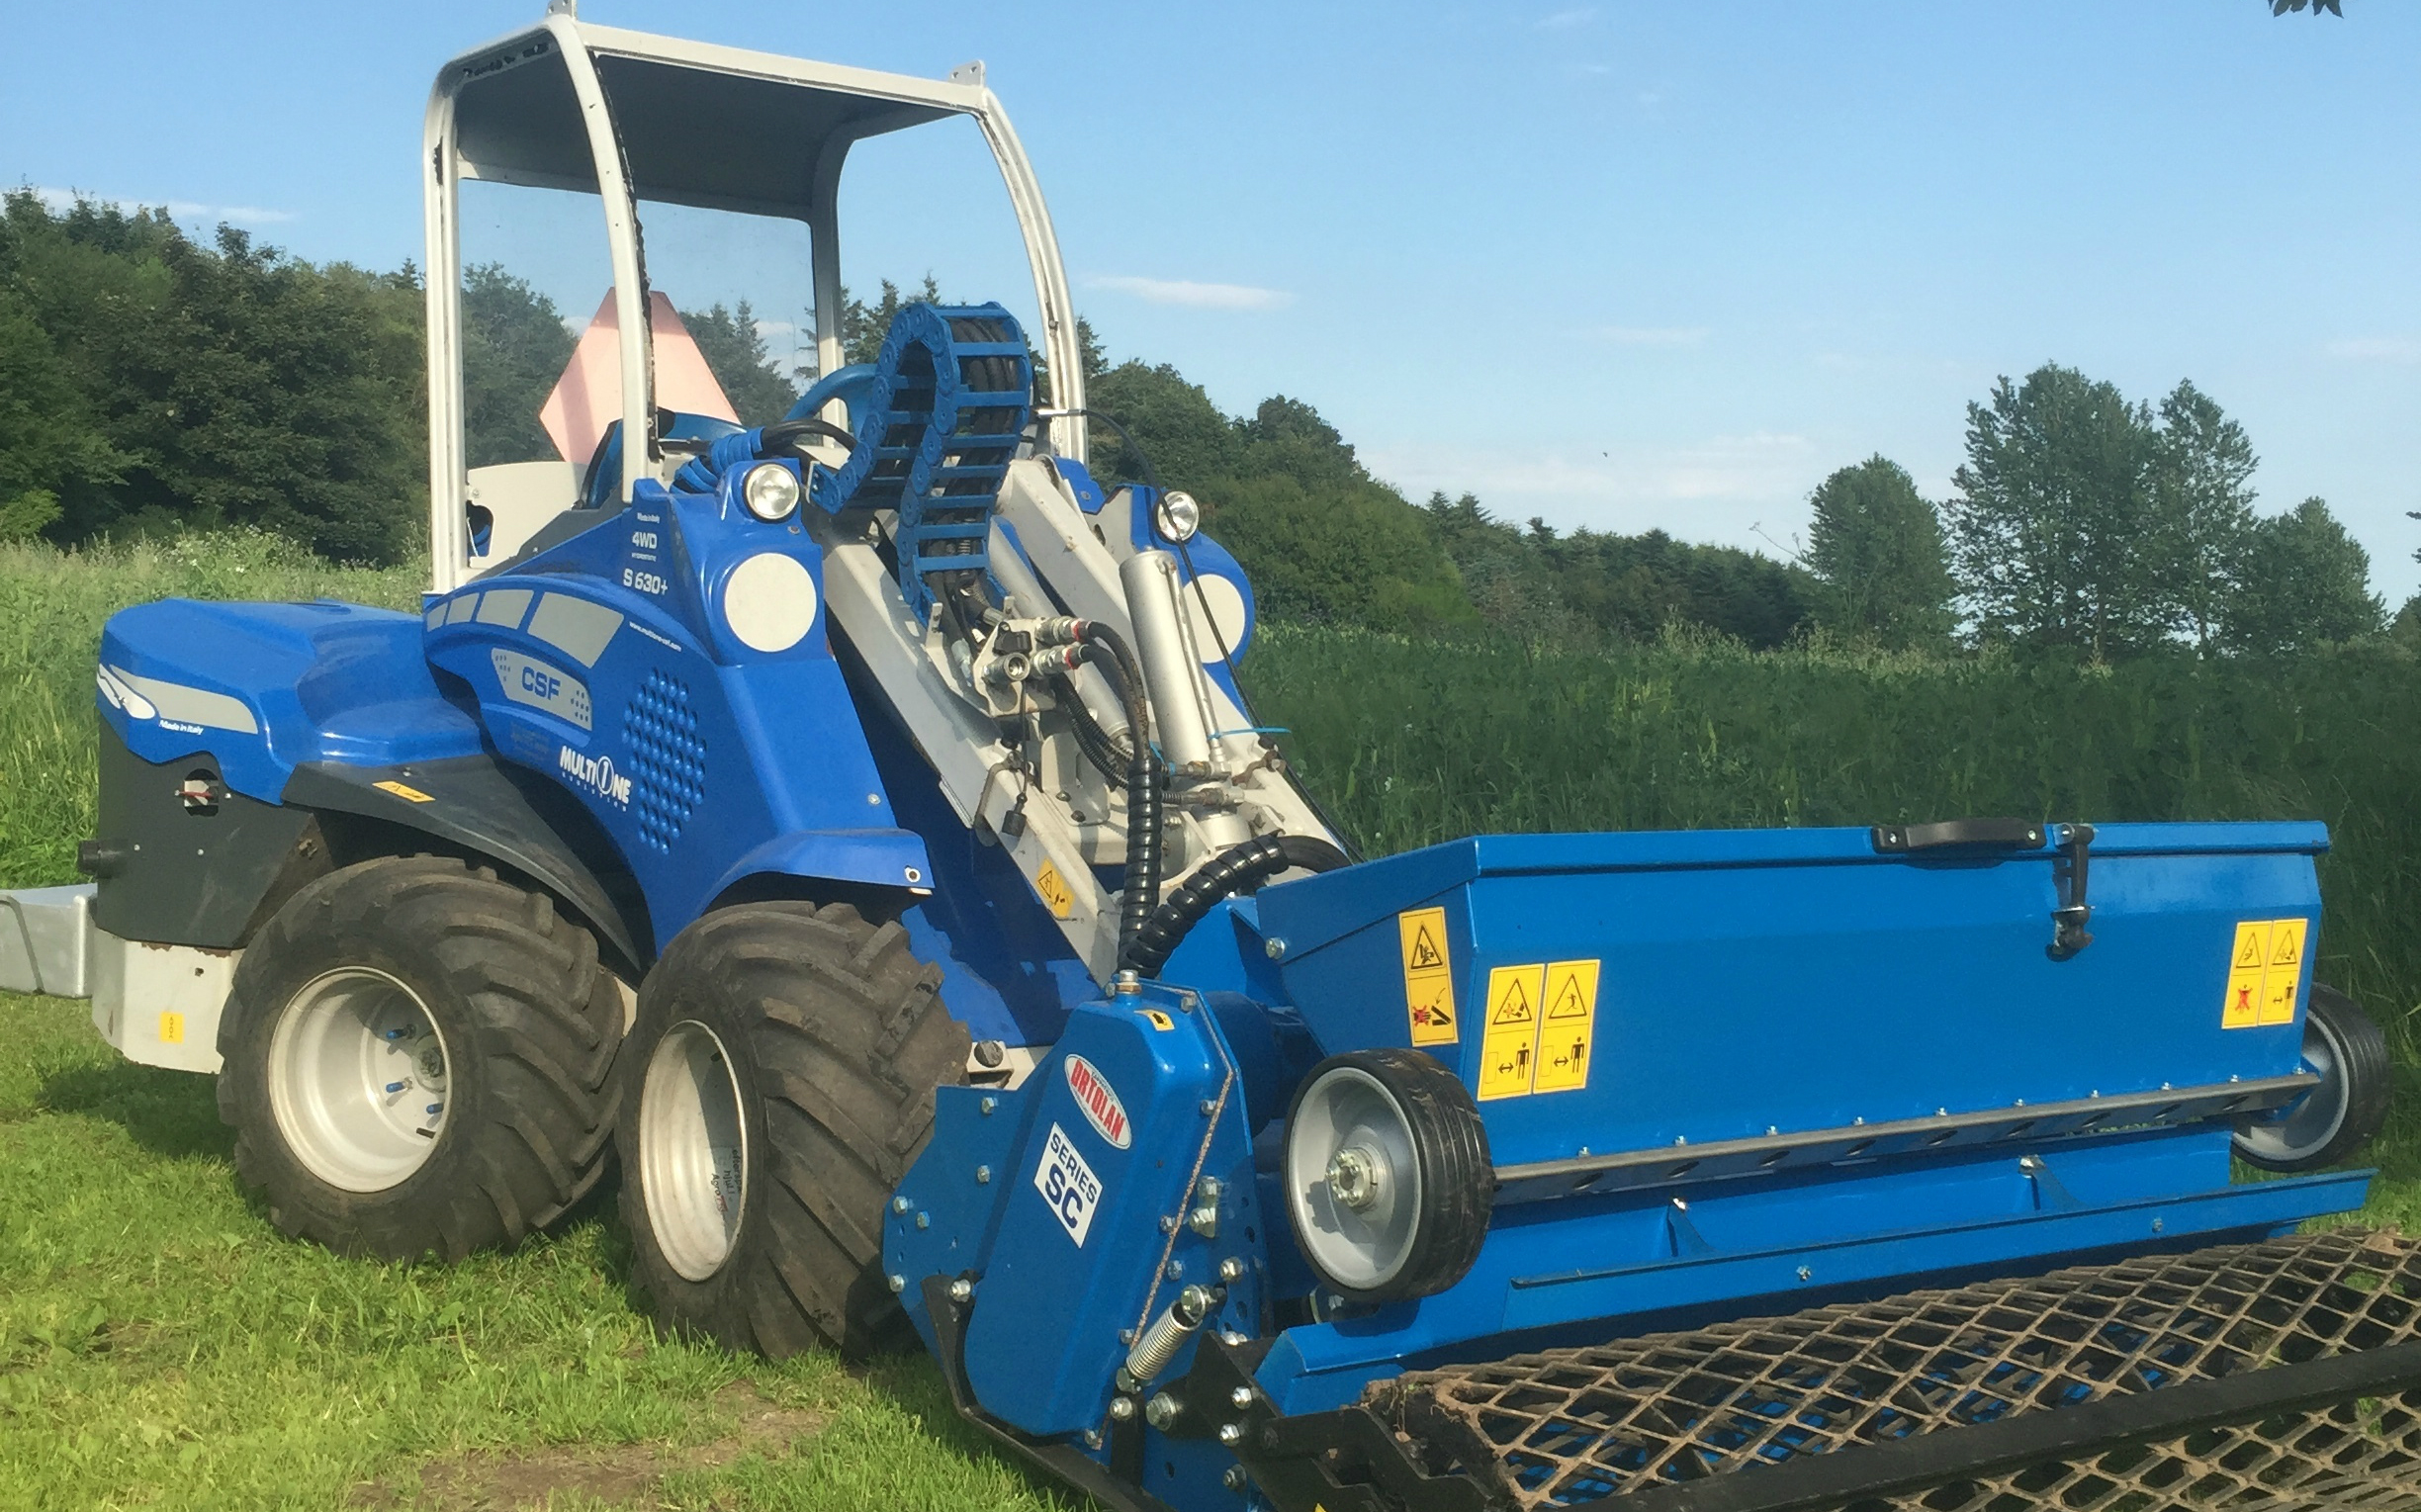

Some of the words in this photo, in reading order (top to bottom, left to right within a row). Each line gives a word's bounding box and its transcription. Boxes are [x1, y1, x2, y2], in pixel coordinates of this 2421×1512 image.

[632, 531, 658, 550] 4WD
[623, 568, 634, 587] S
[634, 572, 668, 595] 630+
[522, 666, 561, 700] CSF
[1070, 1059, 1125, 1142] ORTOLAN
[1050, 1132, 1098, 1204] SERIES
[1045, 1163, 1083, 1229] SC
